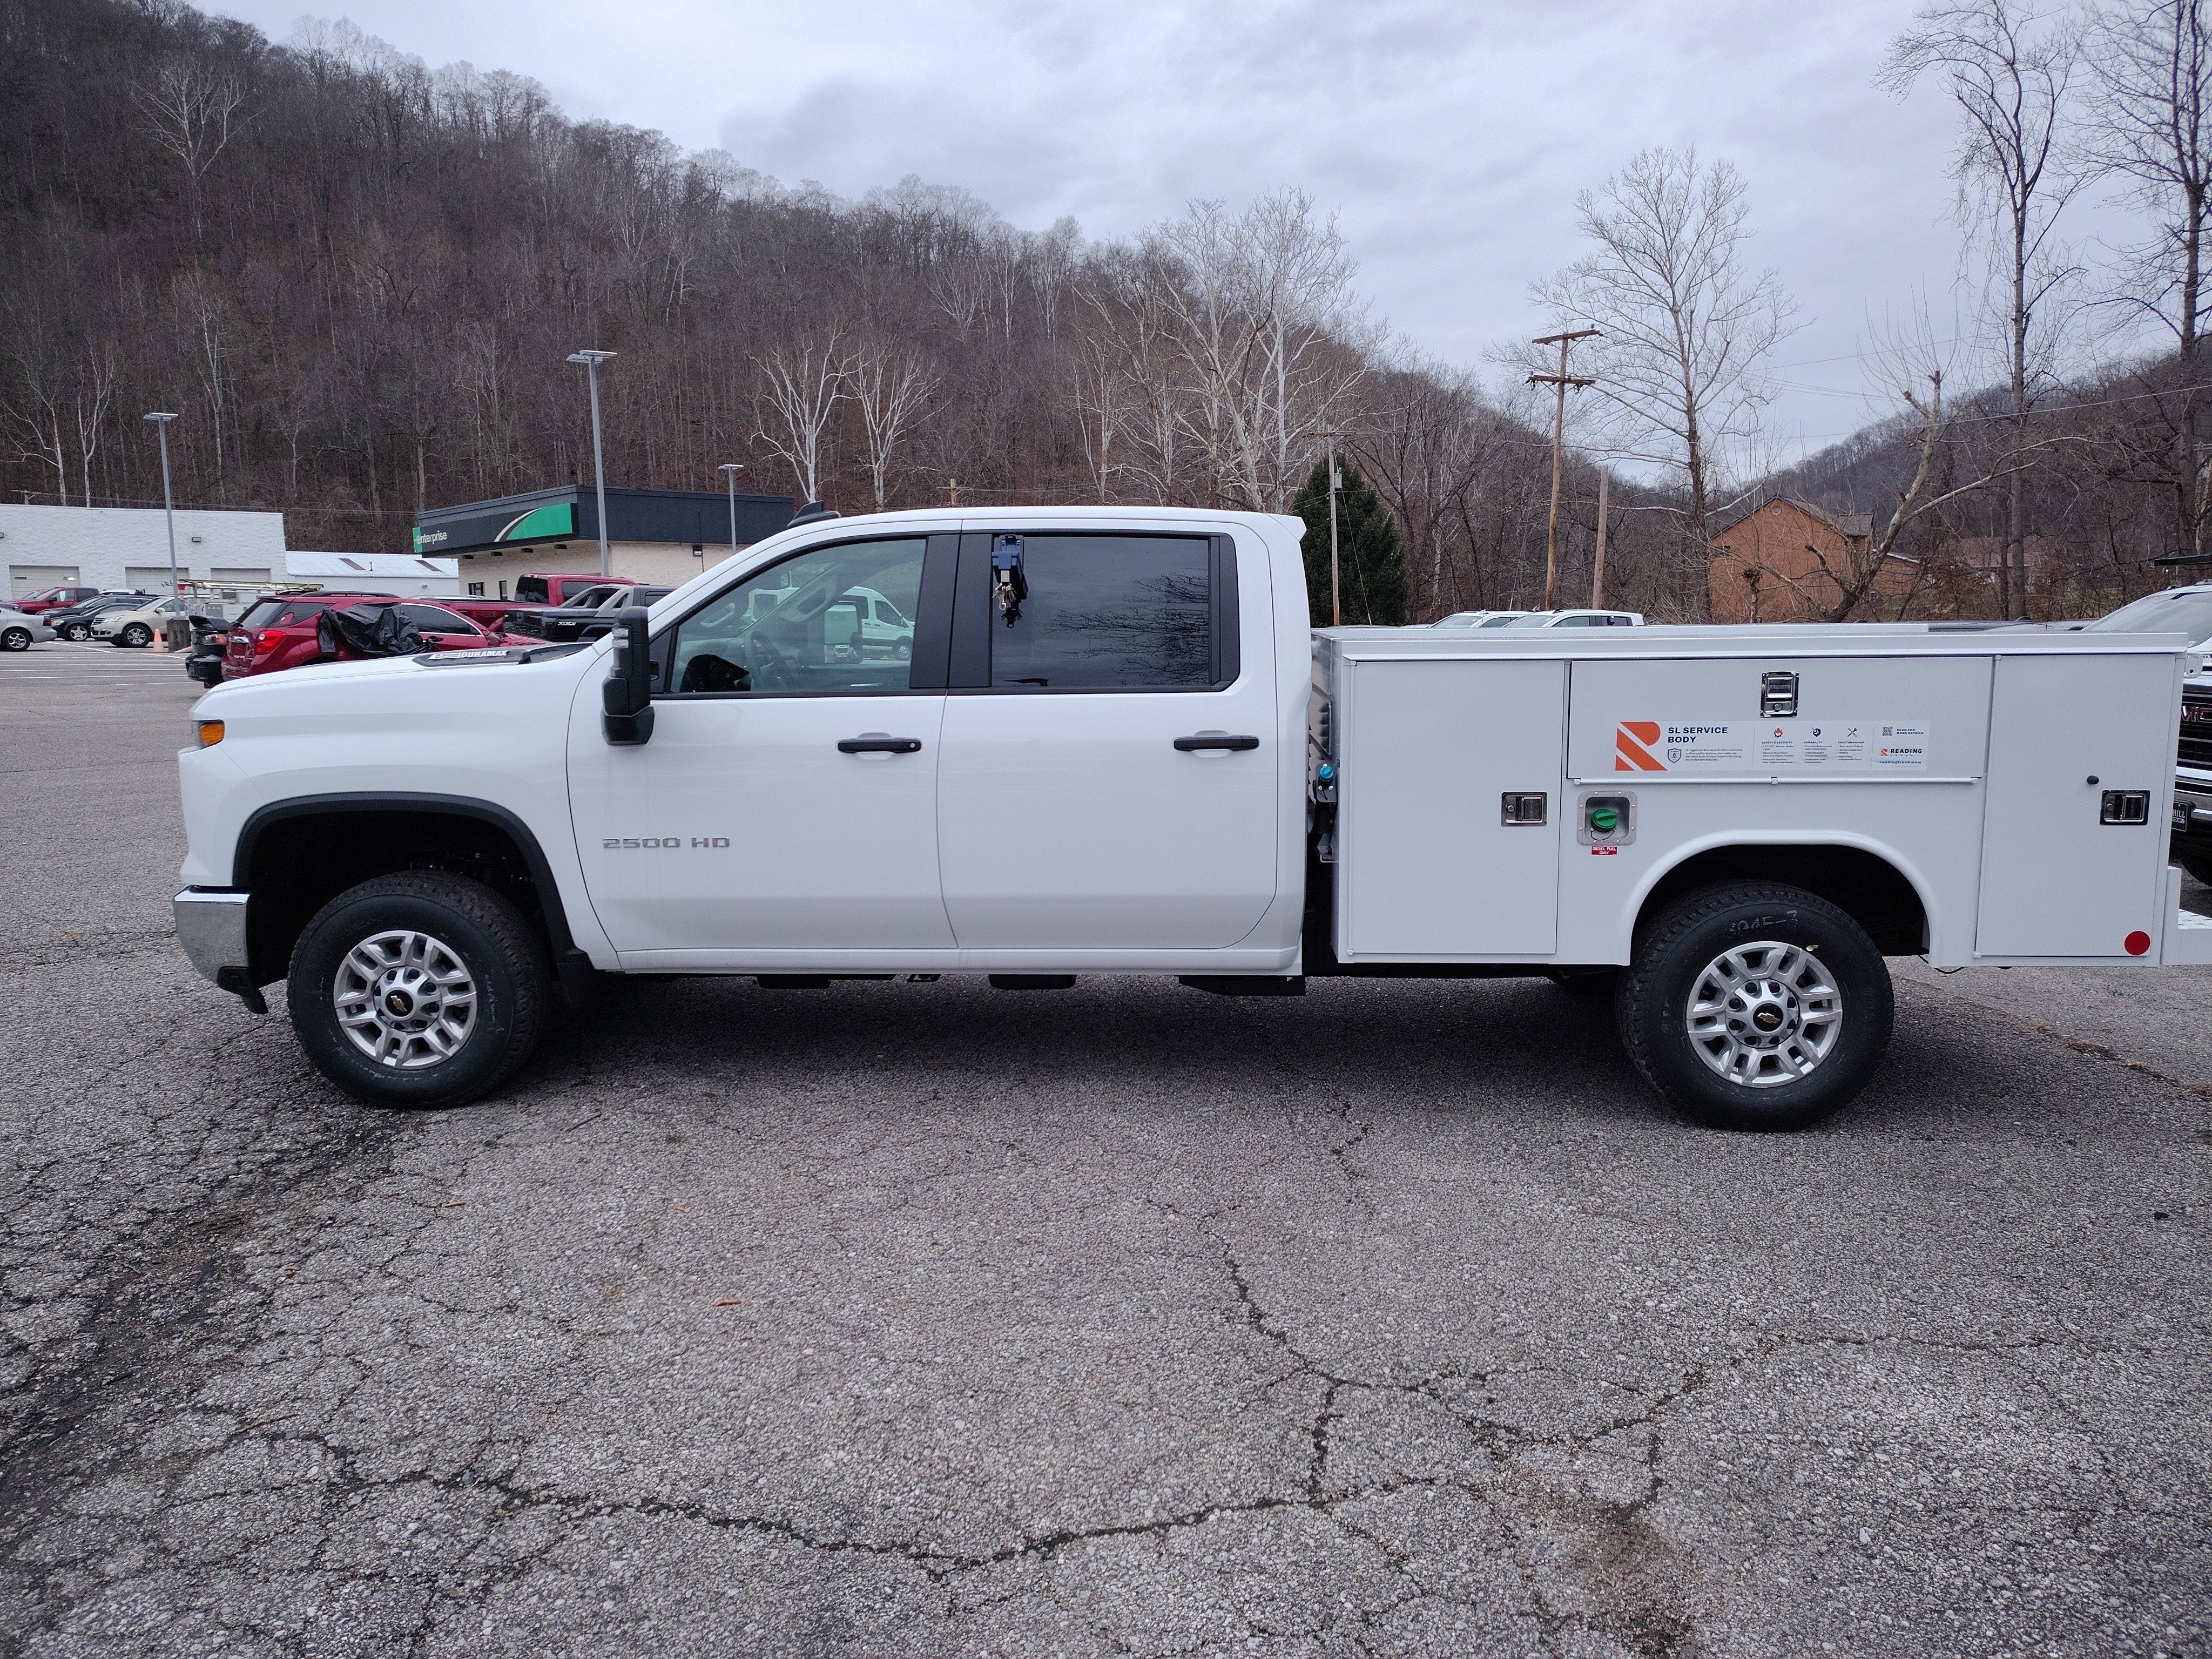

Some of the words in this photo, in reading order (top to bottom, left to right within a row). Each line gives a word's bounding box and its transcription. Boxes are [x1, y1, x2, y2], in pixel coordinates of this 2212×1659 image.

[415, 530, 447, 544] enterprise
[460, 650, 509, 658] DURAMAX
[2181, 705, 2212, 723] MC
[2172, 809, 2186, 818] HILL
[603, 837, 680, 848] 2500
[691, 837, 730, 848] HD
